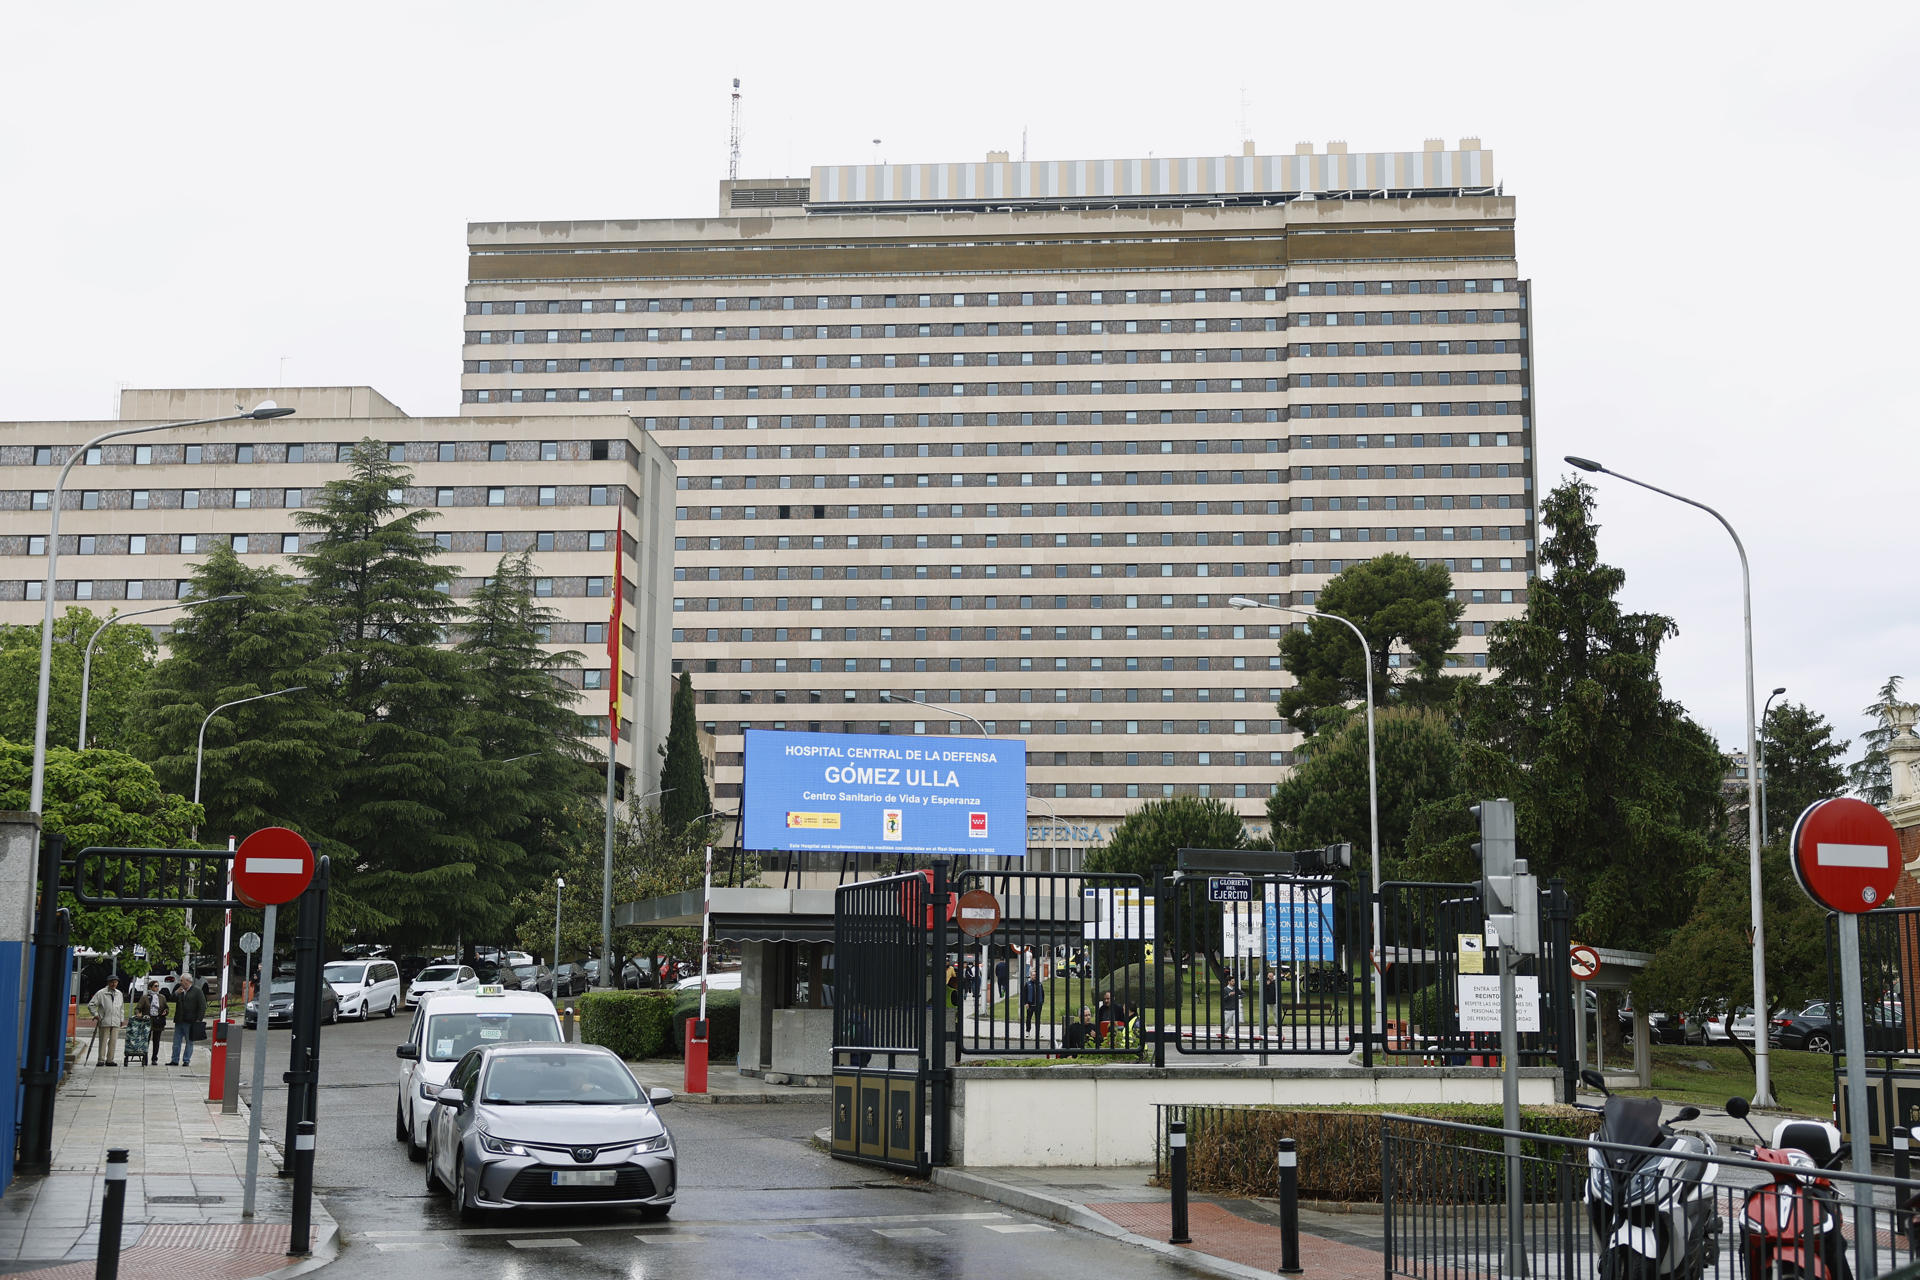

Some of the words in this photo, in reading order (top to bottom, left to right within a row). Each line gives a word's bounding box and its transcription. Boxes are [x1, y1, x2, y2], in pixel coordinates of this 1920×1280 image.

[785, 745, 844, 758] HOSPITAL
[847, 747, 903, 760] CENTRAL
[905, 750, 921, 760] DE
[925, 751, 940, 761] LA
[943, 751, 998, 763] DEFENSA
[824, 761, 900, 785] GÓMEZ
[906, 769, 959, 788] ULLA
[803, 791, 836, 801] Centro
[839, 792, 882, 803] Sanitario
[885, 794, 897, 803] de
[899, 795, 920, 804] Vida
[923, 798, 929, 806] y
[931, 796, 981, 806] Esperanza
[1214, 891, 1248, 900] EJERCITO
